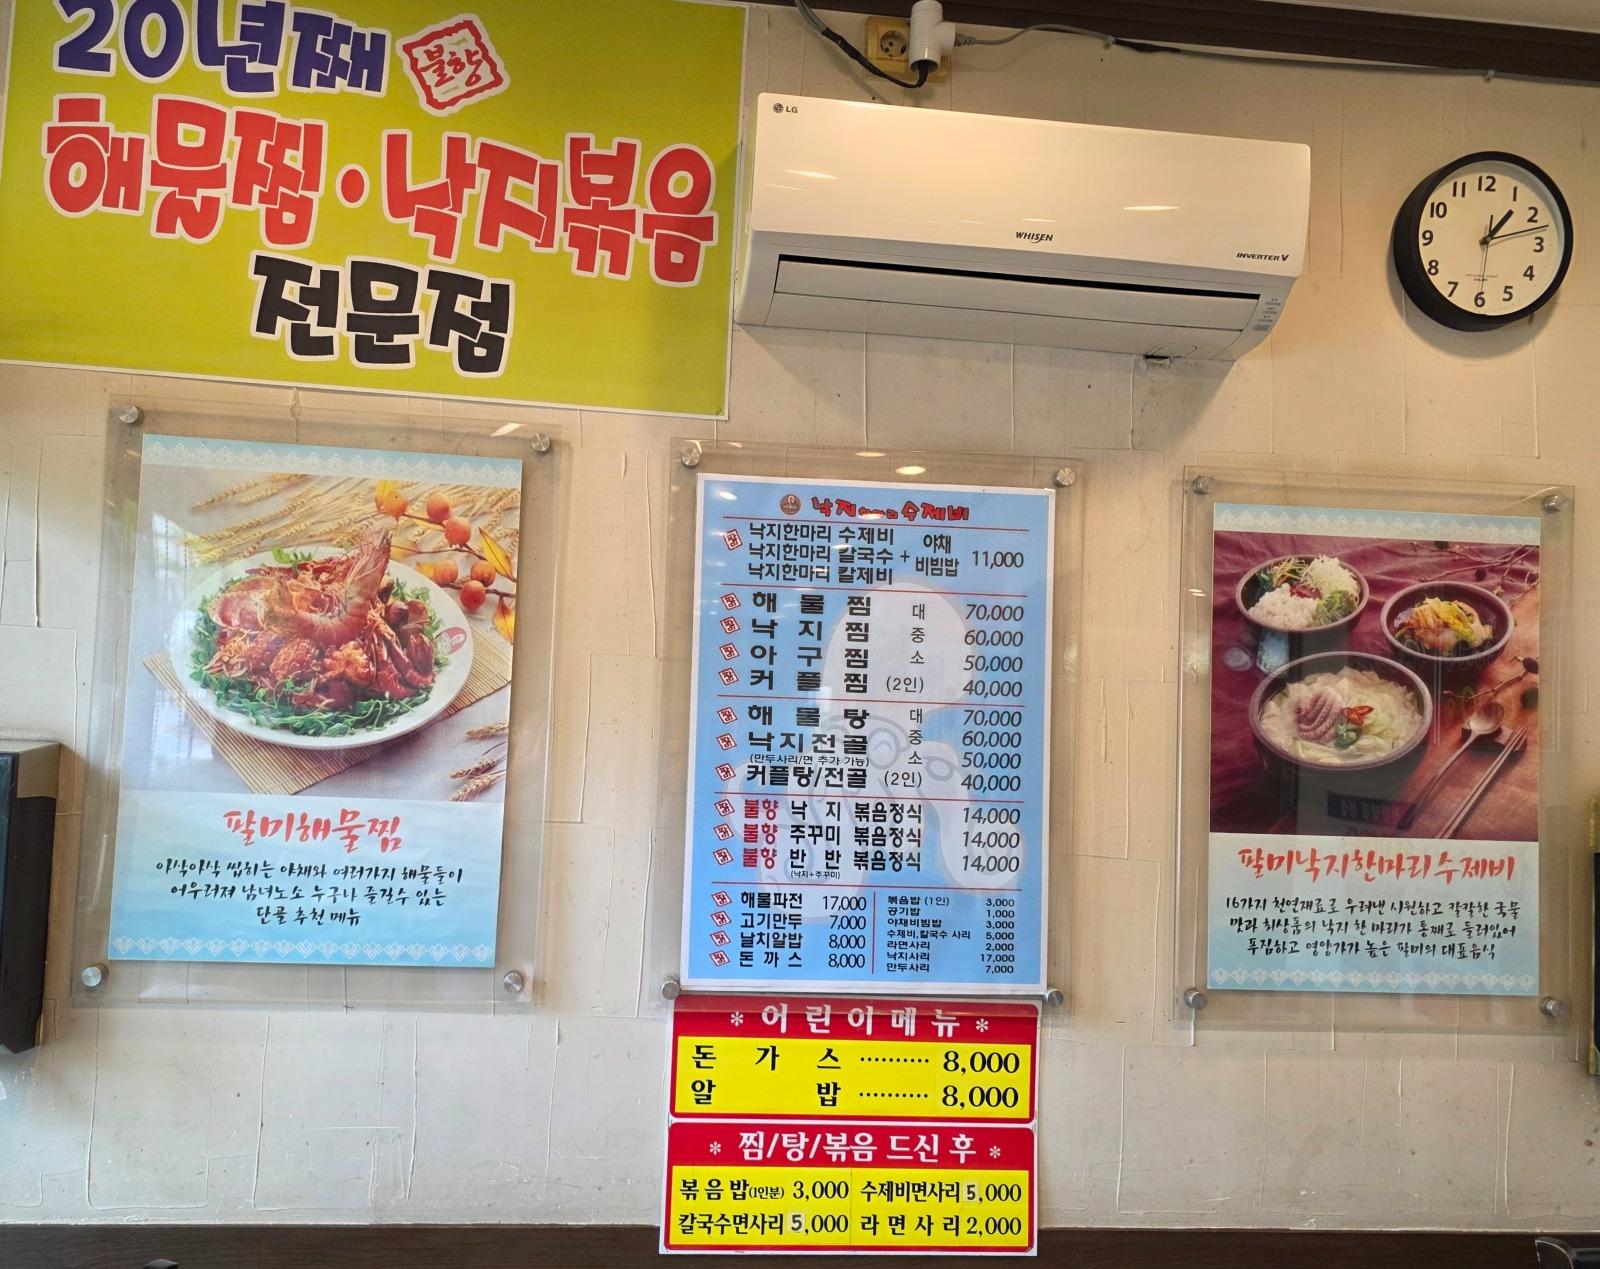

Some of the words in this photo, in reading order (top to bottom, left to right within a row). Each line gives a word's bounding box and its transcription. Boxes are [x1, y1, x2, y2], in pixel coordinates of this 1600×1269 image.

[57, 0, 386, 93] 20년째
[1452, 181, 1466, 198] 11
[1477, 175, 1497, 192] 12
[1512, 186, 1518, 202] 1
[1429, 201, 1448, 219] 10
[1527, 206, 1539, 223] 2
[1015, 231, 1054, 243] WHISEN
[1421, 230, 1434, 246] 9
[1533, 236, 1545, 253] 3
[1236, 253, 1280, 261] INVERTER
[1427, 259, 1439, 276] 8
[1523, 265, 1535, 281] 4
[1447, 281, 1459, 298] 7
[1502, 285, 1514, 302] 5
[1474, 292, 1486, 308] 6
[254, 255, 510, 373] 전문점
[749, 522, 832, 543] 낙지한마리
[838, 526, 894, 545] 수제비
[923, 534, 953, 554] 야채
[748, 543, 831, 563] 낙지한마리
[838, 546, 894, 565] 칼국수
[972, 550, 1025, 569] 11,000
[747, 563, 830, 583] 낙지한마리
[837, 566, 893, 585] 칼제비
[915, 557, 959, 577] 비빔밥
[912, 603, 925, 620] 대
[966, 604, 1024, 621] 70,000
[910, 627, 926, 644] 중
[964, 630, 1024, 647] 60,000
[910, 650, 925, 665] 소
[963, 655, 1023, 673] 50,000
[886, 675, 924, 693] (2인)
[962, 680, 1023, 698] 40,000
[910, 708, 923, 725] 대
[963, 710, 1022, 727] 70,000
[748, 732, 868, 755] 낙지전골
[908, 729, 923, 745] 중
[962, 731, 1021, 748] 60,000
[750, 754, 813, 766] (만두사리/면
[818, 756, 840, 766] 추가
[844, 757, 870, 767] 가능)
[908, 751, 923, 765] 소
[961, 752, 1021, 769] 50,000
[746, 765, 867, 788] 커플탕/전골
[884, 772, 922, 788] (2인)
[961, 774, 1021, 793] 40,000
[743, 799, 778, 820] 불향
[854, 802, 921, 824] 볶음정식
[963, 808, 1020, 825] 14,000
[224, 808, 402, 853] 팔미해물찜
[743, 823, 778, 844] 불향
[790, 824, 840, 845] 주꾸미
[854, 826, 921, 848] 볶음정식
[962, 831, 1020, 849] 14,000
[743, 847, 777, 869] 불향
[854, 850, 921, 872] 볶음정식
[962, 855, 1019, 873] 14,000
[156, 858, 220, 878] 아삭아삭
[227, 860, 275, 879] 씹히는
[280, 862, 327, 879] 야채와
[333, 865, 396, 881] 여러가지
[401, 864, 463, 884] 해물들이
[171, 881, 236, 900] 어우러져
[242, 884, 304, 901] 남녀노소
[311, 885, 357, 904] 누구나
[416, 888, 447, 906] 있는
[741, 891, 802, 909] 해물파전
[888, 896, 920, 905] 볶음밥
[925, 896, 950, 906] (1인)
[823, 896, 866, 911] 17,000
[986, 898, 1014, 907] 3,000
[1226, 897, 1267, 911] 16가지
[1272, 896, 1340, 914] 천연재료로
[1345, 898, 1386, 915] 우려낸
[1391, 900, 1443, 916] 시원하고
[1494, 901, 1520, 919] 국물
[257, 906, 287, 925] 단골
[294, 907, 325, 926] 추천
[330, 908, 361, 926] 메뉴
[888, 907, 920, 916] 공기밥
[987, 909, 1014, 918] 1,000
[740, 912, 802, 930] 고기만두
[830, 915, 866, 930] 7,000
[986, 921, 1014, 930] 3,000
[1230, 917, 1258, 933] 맛과
[1262, 917, 1316, 935] 최상품의
[1322, 919, 1348, 936] 낙지
[1354, 919, 1367, 936] 한
[1372, 920, 1412, 935] 마리가
[1418, 920, 1456, 938] 통째로
[740, 931, 802, 948] 날치알밥
[829, 934, 865, 949] 8,000
[952, 930, 970, 940] 사리
[986, 932, 1014, 941] 5,000
[887, 941, 930, 951] 라면사리
[986, 943, 1014, 952] 2,000
[1247, 937, 1300, 956] 푸짐하고
[1306, 939, 1360, 957] 영양가가
[1365, 940, 1391, 958] 높은
[1397, 941, 1436, 958] 팔미의
[1441, 942, 1495, 960] 대표음식
[828, 954, 865, 968] 8,000
[887, 952, 930, 962] 낙지사리
[981, 954, 1014, 963] 17,000
[887, 963, 930, 972] 만두사리
[986, 965, 1014, 974] 7,000
[942, 1051, 1020, 1074] 8,000
[941, 1086, 1019, 1109] 8,000
[886, 1135, 938, 1163] 드신
[949, 1134, 976, 1164] 후
[793, 1181, 849, 1201] 3,000
[861, 1181, 960, 1203] 수제비면사리
[966, 1183, 1021, 1203] 5,000
[679, 1213, 784, 1236] 칼국수면사리
[791, 1214, 848, 1234] 5,000
[966, 1216, 1021, 1236] 2,000
